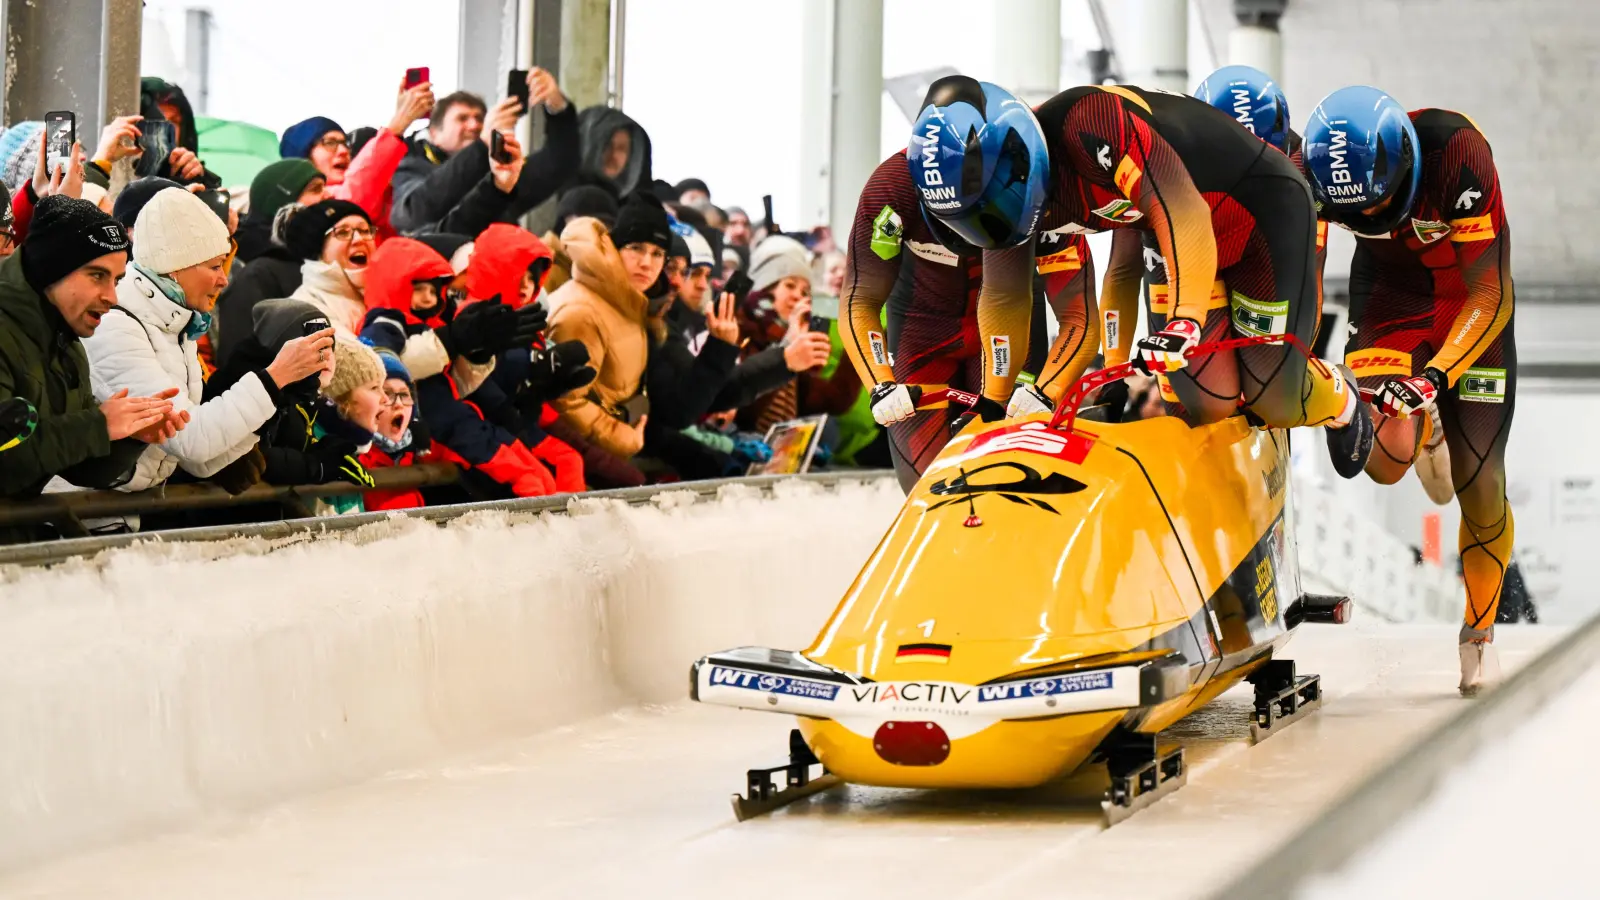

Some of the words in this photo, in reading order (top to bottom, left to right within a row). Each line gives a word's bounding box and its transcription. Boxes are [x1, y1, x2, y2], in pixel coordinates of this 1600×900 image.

[922, 124, 944, 186] BMW
[1328, 130, 1352, 184] BMW
[922, 186, 956, 201] BMW
[1327, 183, 1363, 196] BMW
[927, 200, 962, 210] helmets
[1331, 195, 1367, 204] helmets
[102, 225, 121, 237] TSV
[1452, 223, 1484, 235] DHL
[1141, 336, 1170, 349] SEIZ
[1351, 356, 1404, 370] DHL
[1388, 381, 1412, 403] SEIZ
[917, 618, 935, 638] 1
[713, 668, 759, 687] WT
[789, 679, 834, 690] ENERGIE
[785, 685, 834, 699] SYSTEME
[982, 682, 1028, 700] WT
[1059, 679, 1109, 692] SYSTEME
[852, 682, 971, 704] VIACTIV
